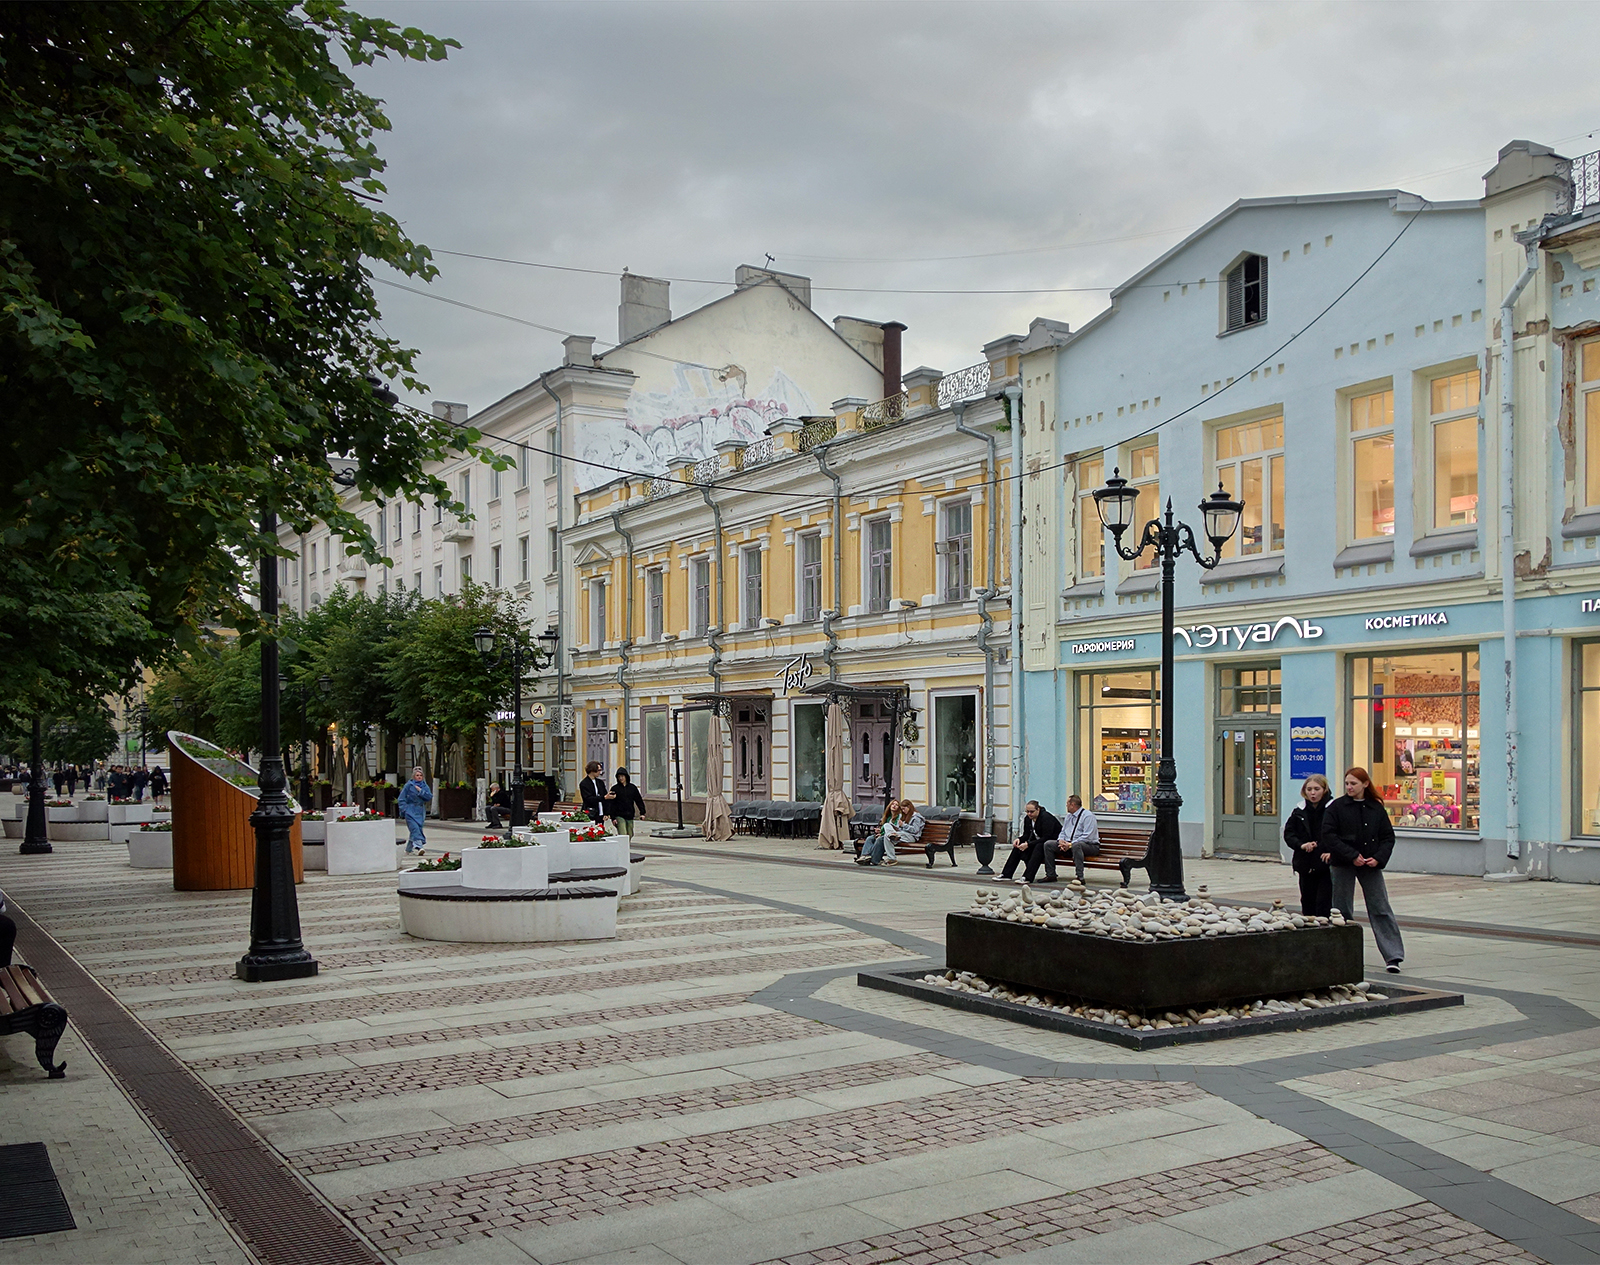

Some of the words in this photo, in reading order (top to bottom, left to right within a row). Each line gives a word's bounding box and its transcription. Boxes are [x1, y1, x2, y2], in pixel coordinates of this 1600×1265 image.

[1365, 611, 1448, 630] КОСМЕТИКА
[1071, 639, 1136, 654] ПАРФЮМЕРИЯ
[774, 653, 813, 696] Testo
[497, 711, 516, 720] БИСТР
